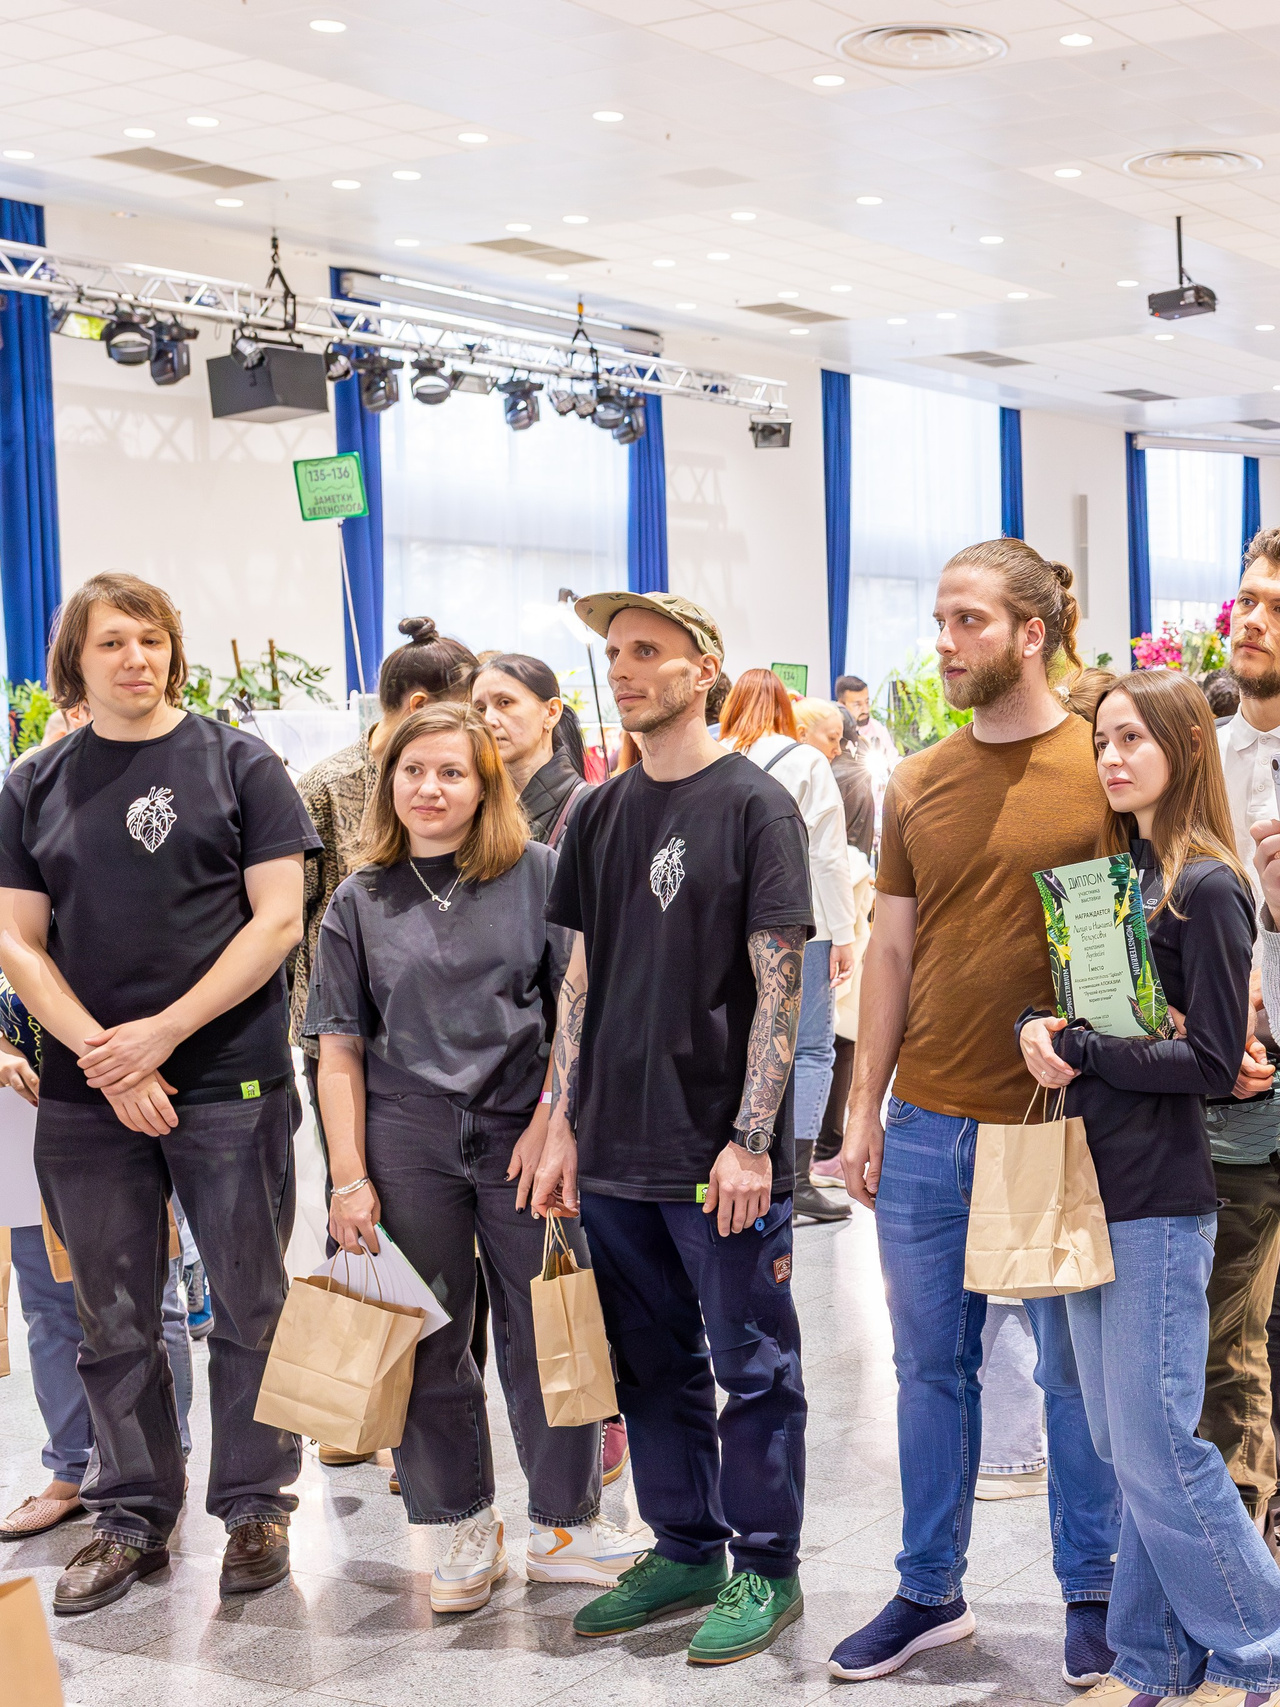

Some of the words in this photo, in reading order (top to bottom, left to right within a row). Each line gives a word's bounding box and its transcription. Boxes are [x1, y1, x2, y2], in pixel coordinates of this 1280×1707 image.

[308, 467, 350, 483] 135-136
[314, 493, 353, 506] ЗАМЕТКИ
[307, 502, 363, 517] ЗЕЛЕНОЛОГА
[1068, 872, 1106, 890] ДИПЛОМ
[1075, 908, 1111, 920] НАГРАЖДАЕТСЯ
